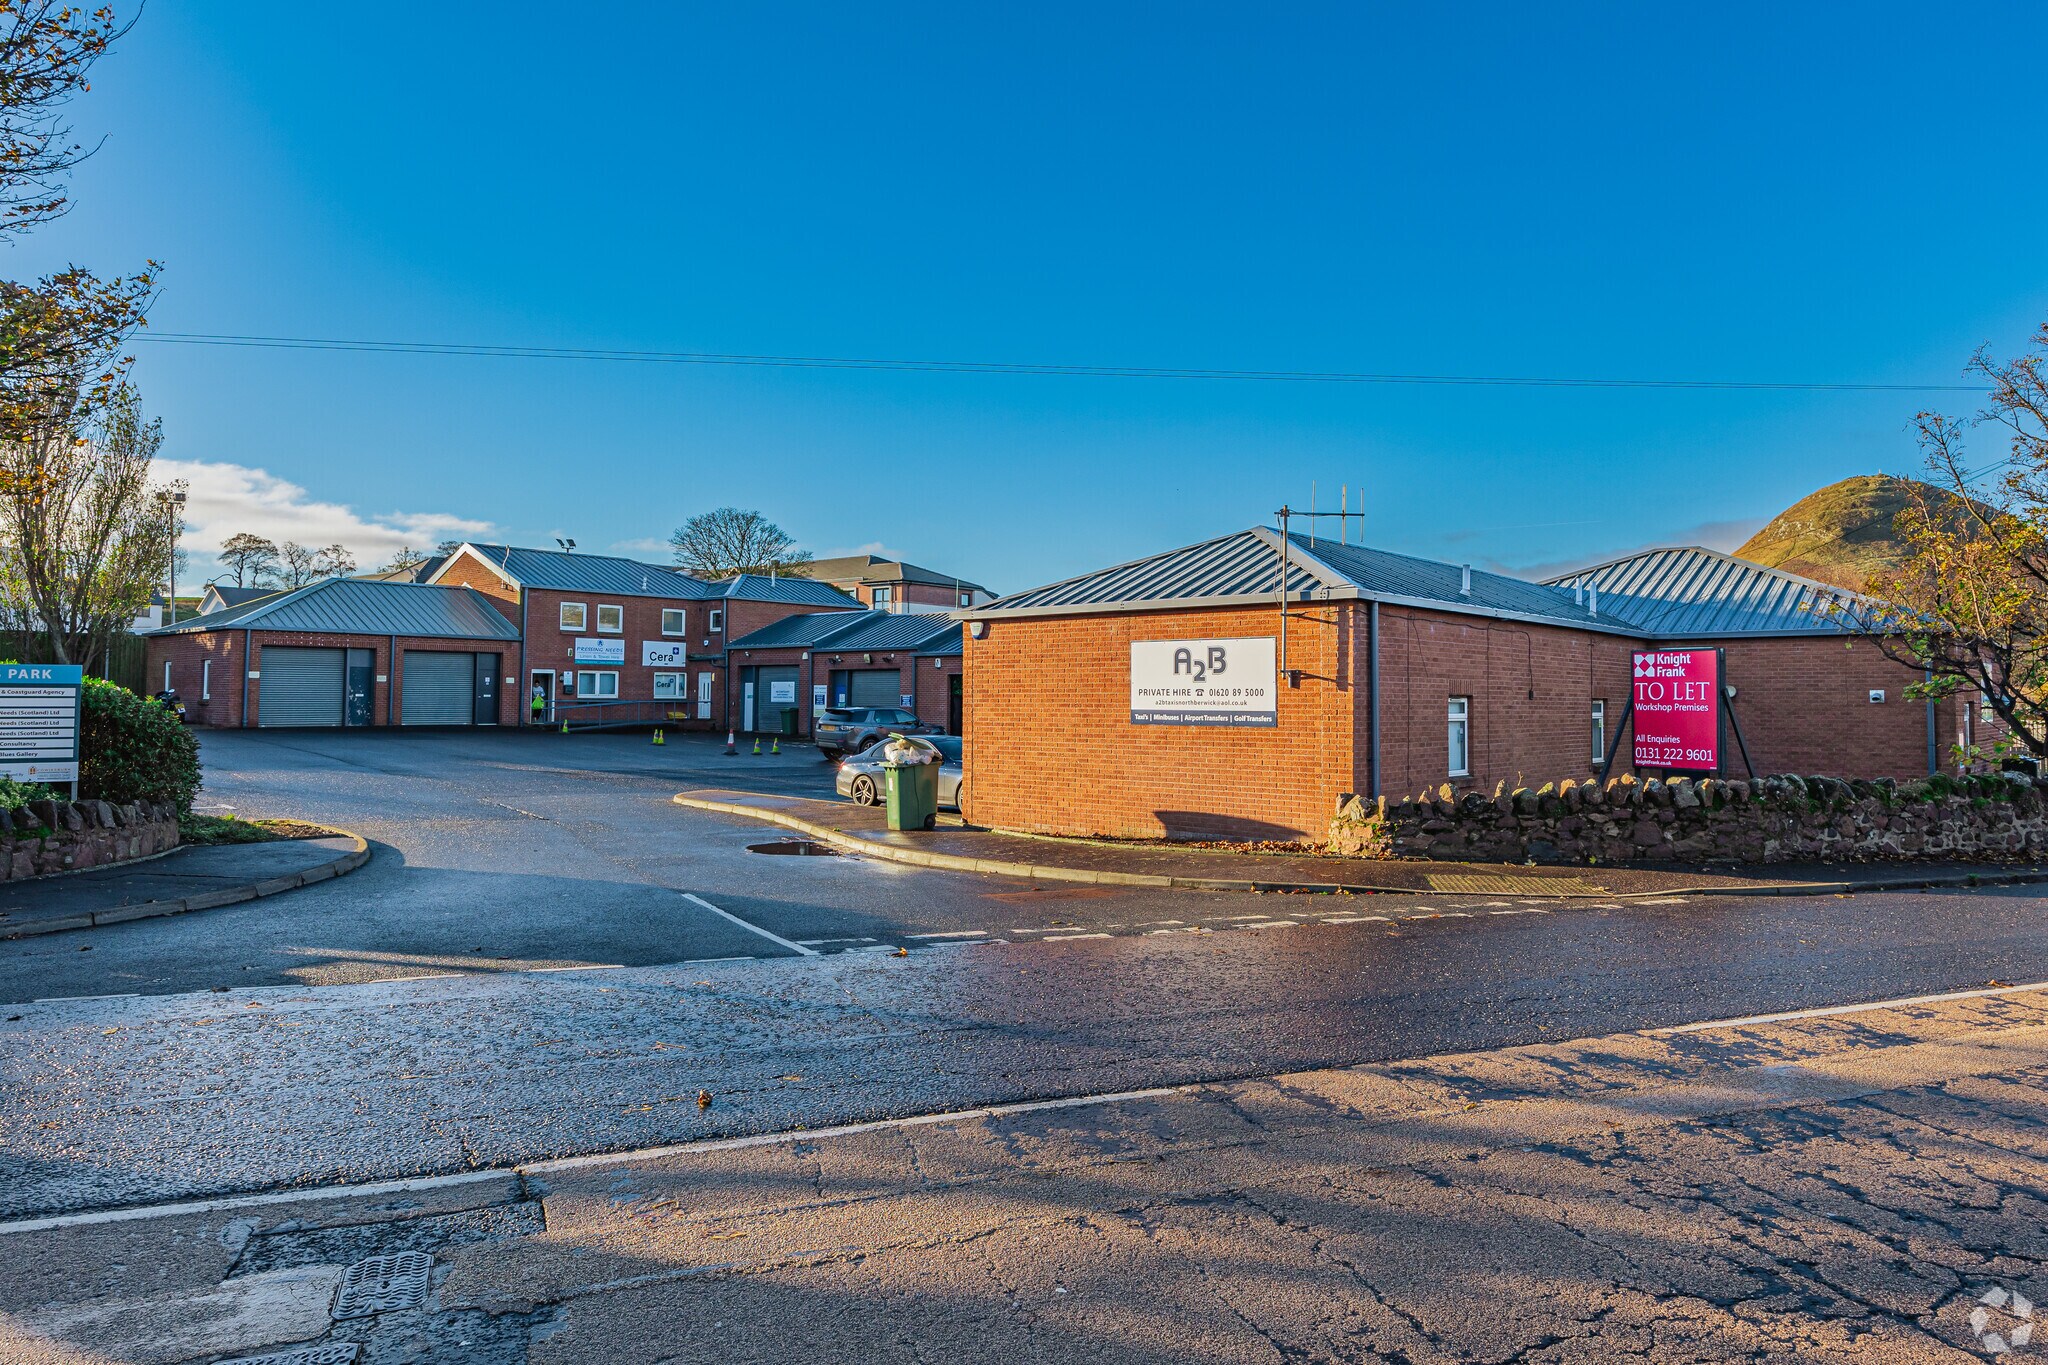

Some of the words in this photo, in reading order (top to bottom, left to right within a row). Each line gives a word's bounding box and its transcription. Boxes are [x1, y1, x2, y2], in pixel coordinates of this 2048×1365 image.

[649, 651, 674, 661] Cera
[1656, 653, 1691, 667] Knight
[1173, 646, 1228, 683] A2B
[8, 668, 52, 679] PARK
[1656, 666, 1686, 677] Frank
[1138, 688, 1170, 697] PRIVATE
[1172, 688, 1191, 697] HIRE
[1208, 688, 1230, 697] 01620
[1232, 688, 1242, 697] 89
[1245, 688, 1264, 697] 5000
[1634, 682, 1664, 701] TO
[1673, 682, 1710, 701] LET
[1635, 703, 1672, 713] Workshop
[1674, 703, 1709, 712] Premises
[1153, 713, 1180, 721] Minibuses
[1184, 714, 1204, 722] Airport
[1204, 714, 1229, 722] Transfers
[1635, 734, 1645, 742] All
[1647, 734, 1680, 744] Enquiries
[1635, 747, 1660, 759] 0131
[1663, 748, 1683, 760] 222
[1686, 749, 1714, 762] 9601
